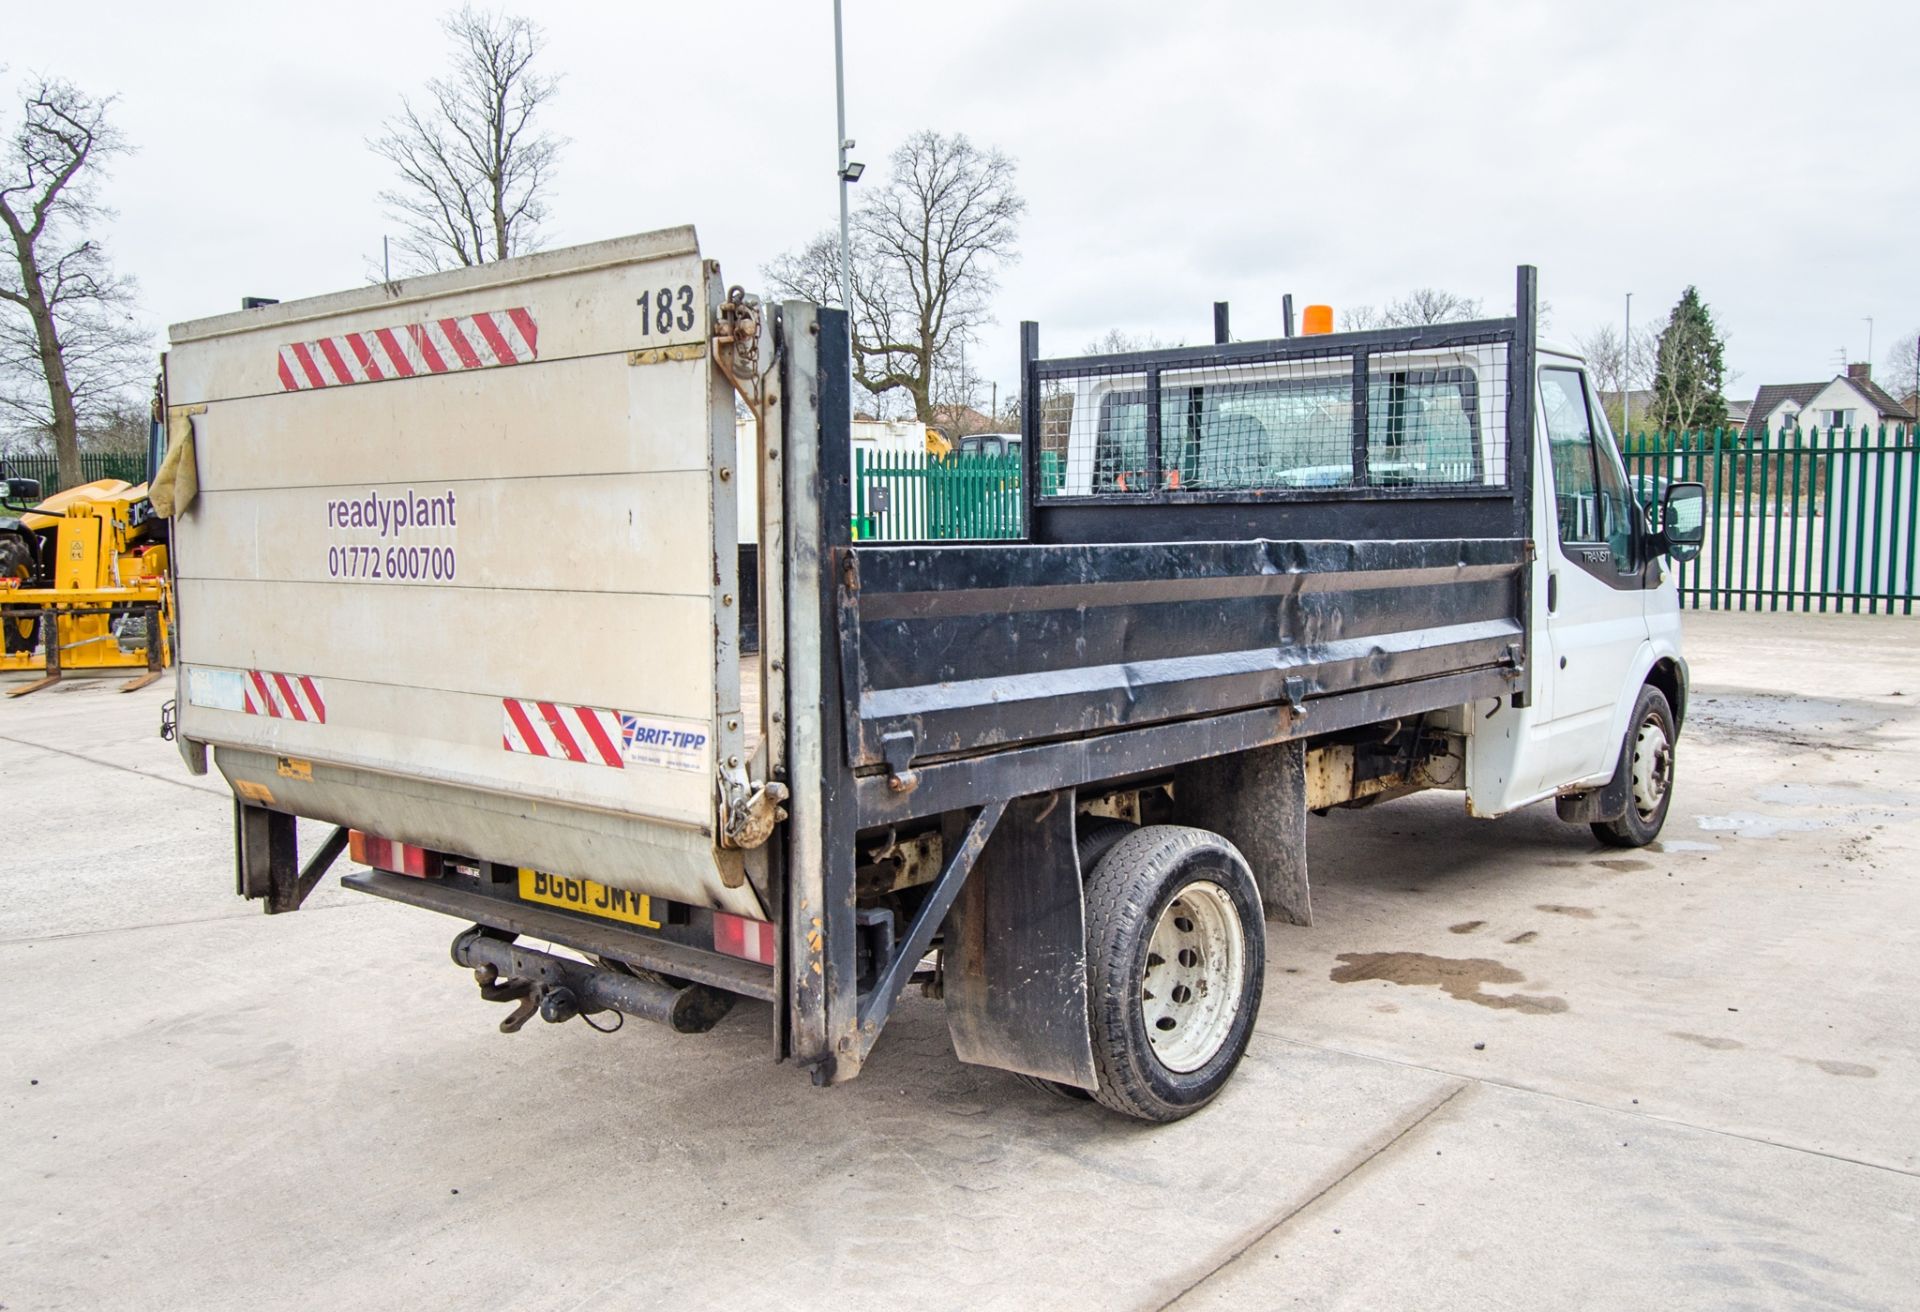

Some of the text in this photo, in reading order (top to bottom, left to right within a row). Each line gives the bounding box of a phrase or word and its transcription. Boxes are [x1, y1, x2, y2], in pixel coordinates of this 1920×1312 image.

[636, 284, 695, 336] 183
[328, 490, 456, 537] readyplant
[328, 546, 455, 580] 01772 600700
[1582, 551, 1611, 563] TRANSIT
[635, 727, 706, 750] BRIT-TIPP
[534, 870, 587, 905] BG61
